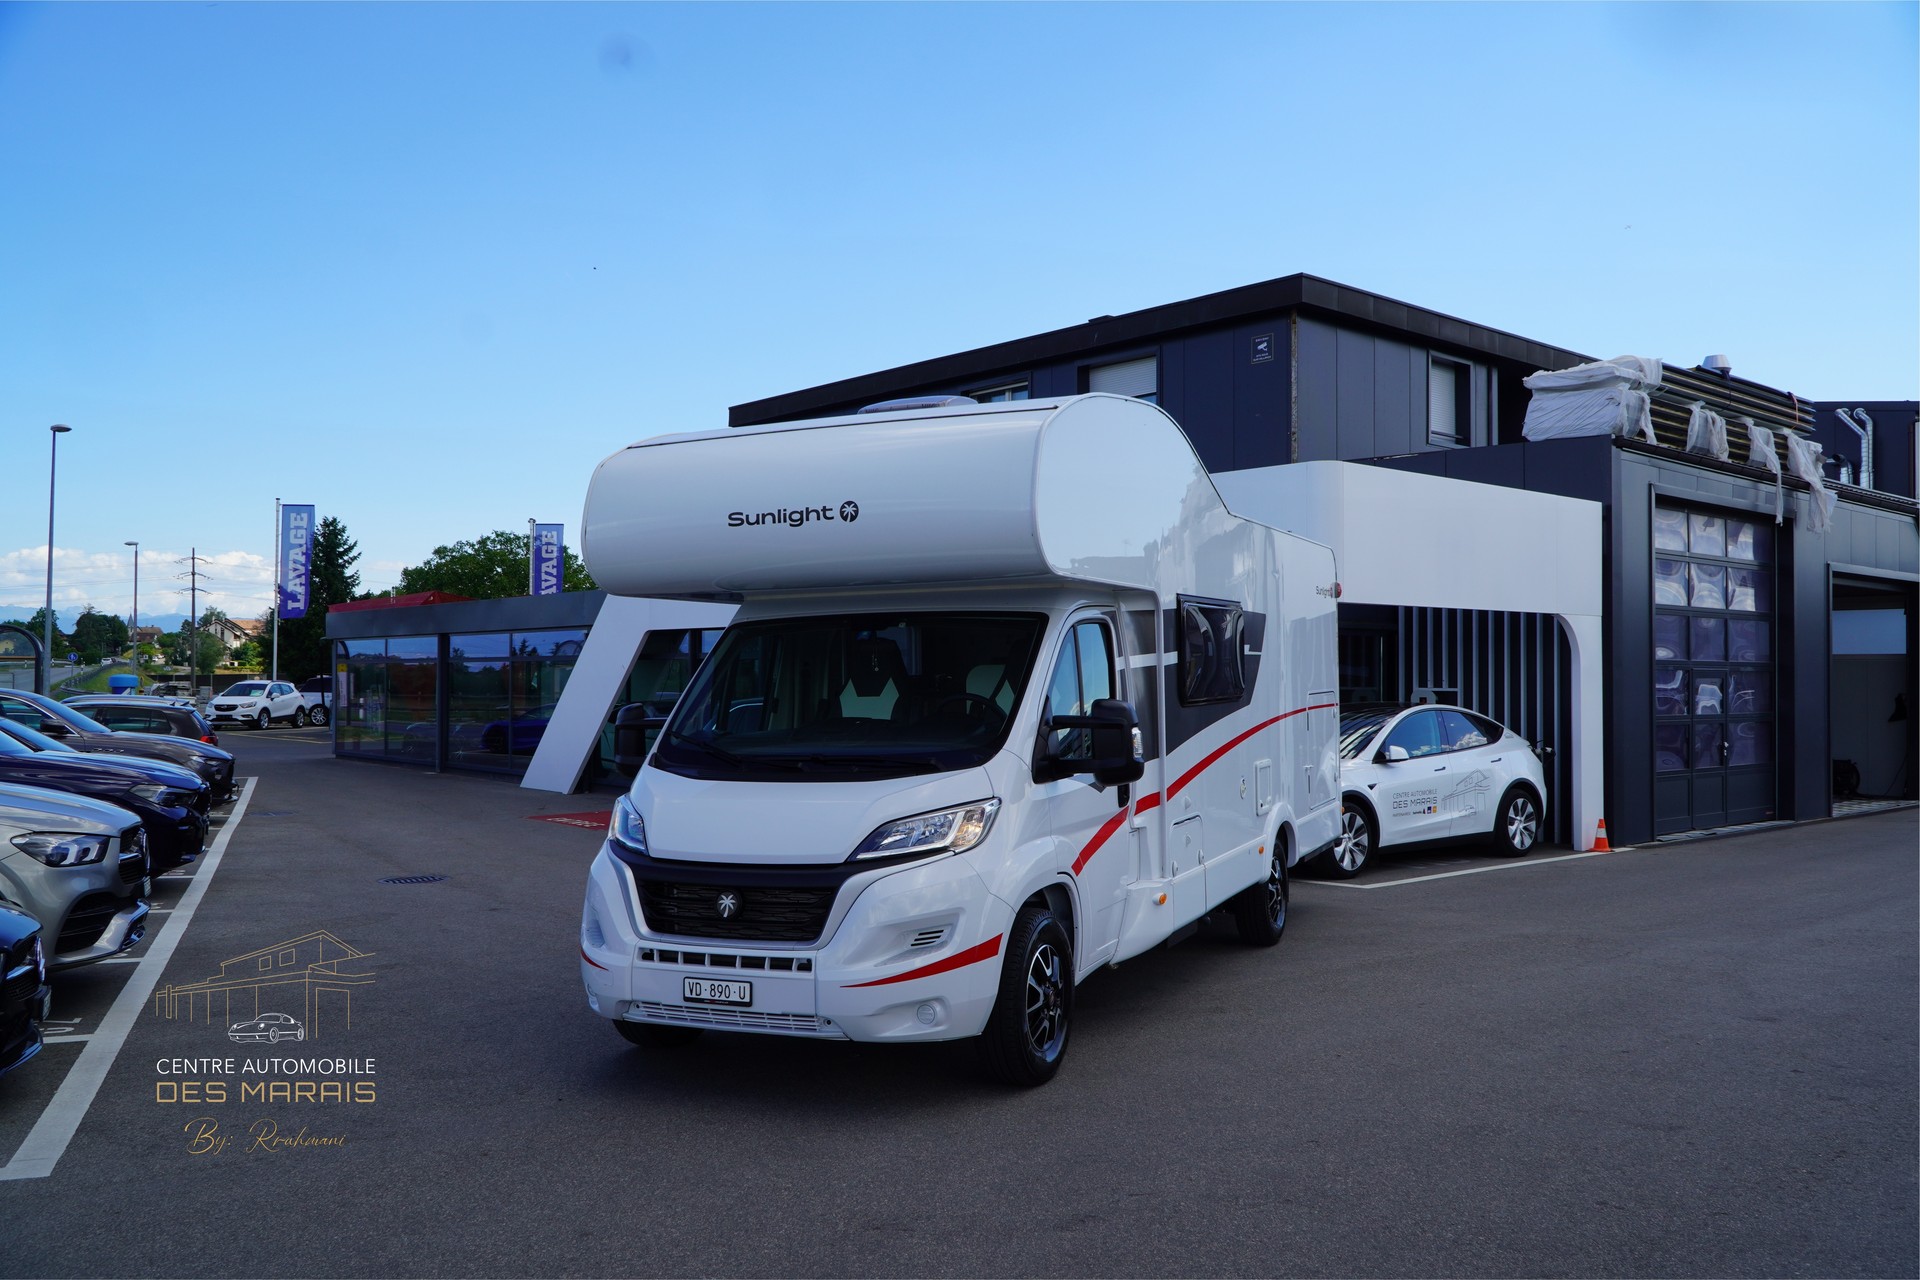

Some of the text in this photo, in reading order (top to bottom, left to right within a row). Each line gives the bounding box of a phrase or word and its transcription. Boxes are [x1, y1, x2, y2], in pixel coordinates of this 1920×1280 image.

[727, 505, 835, 528] Sunlight
[287, 512, 308, 610] LAVAGE
[1392, 796, 1438, 810] DES MARAIS
